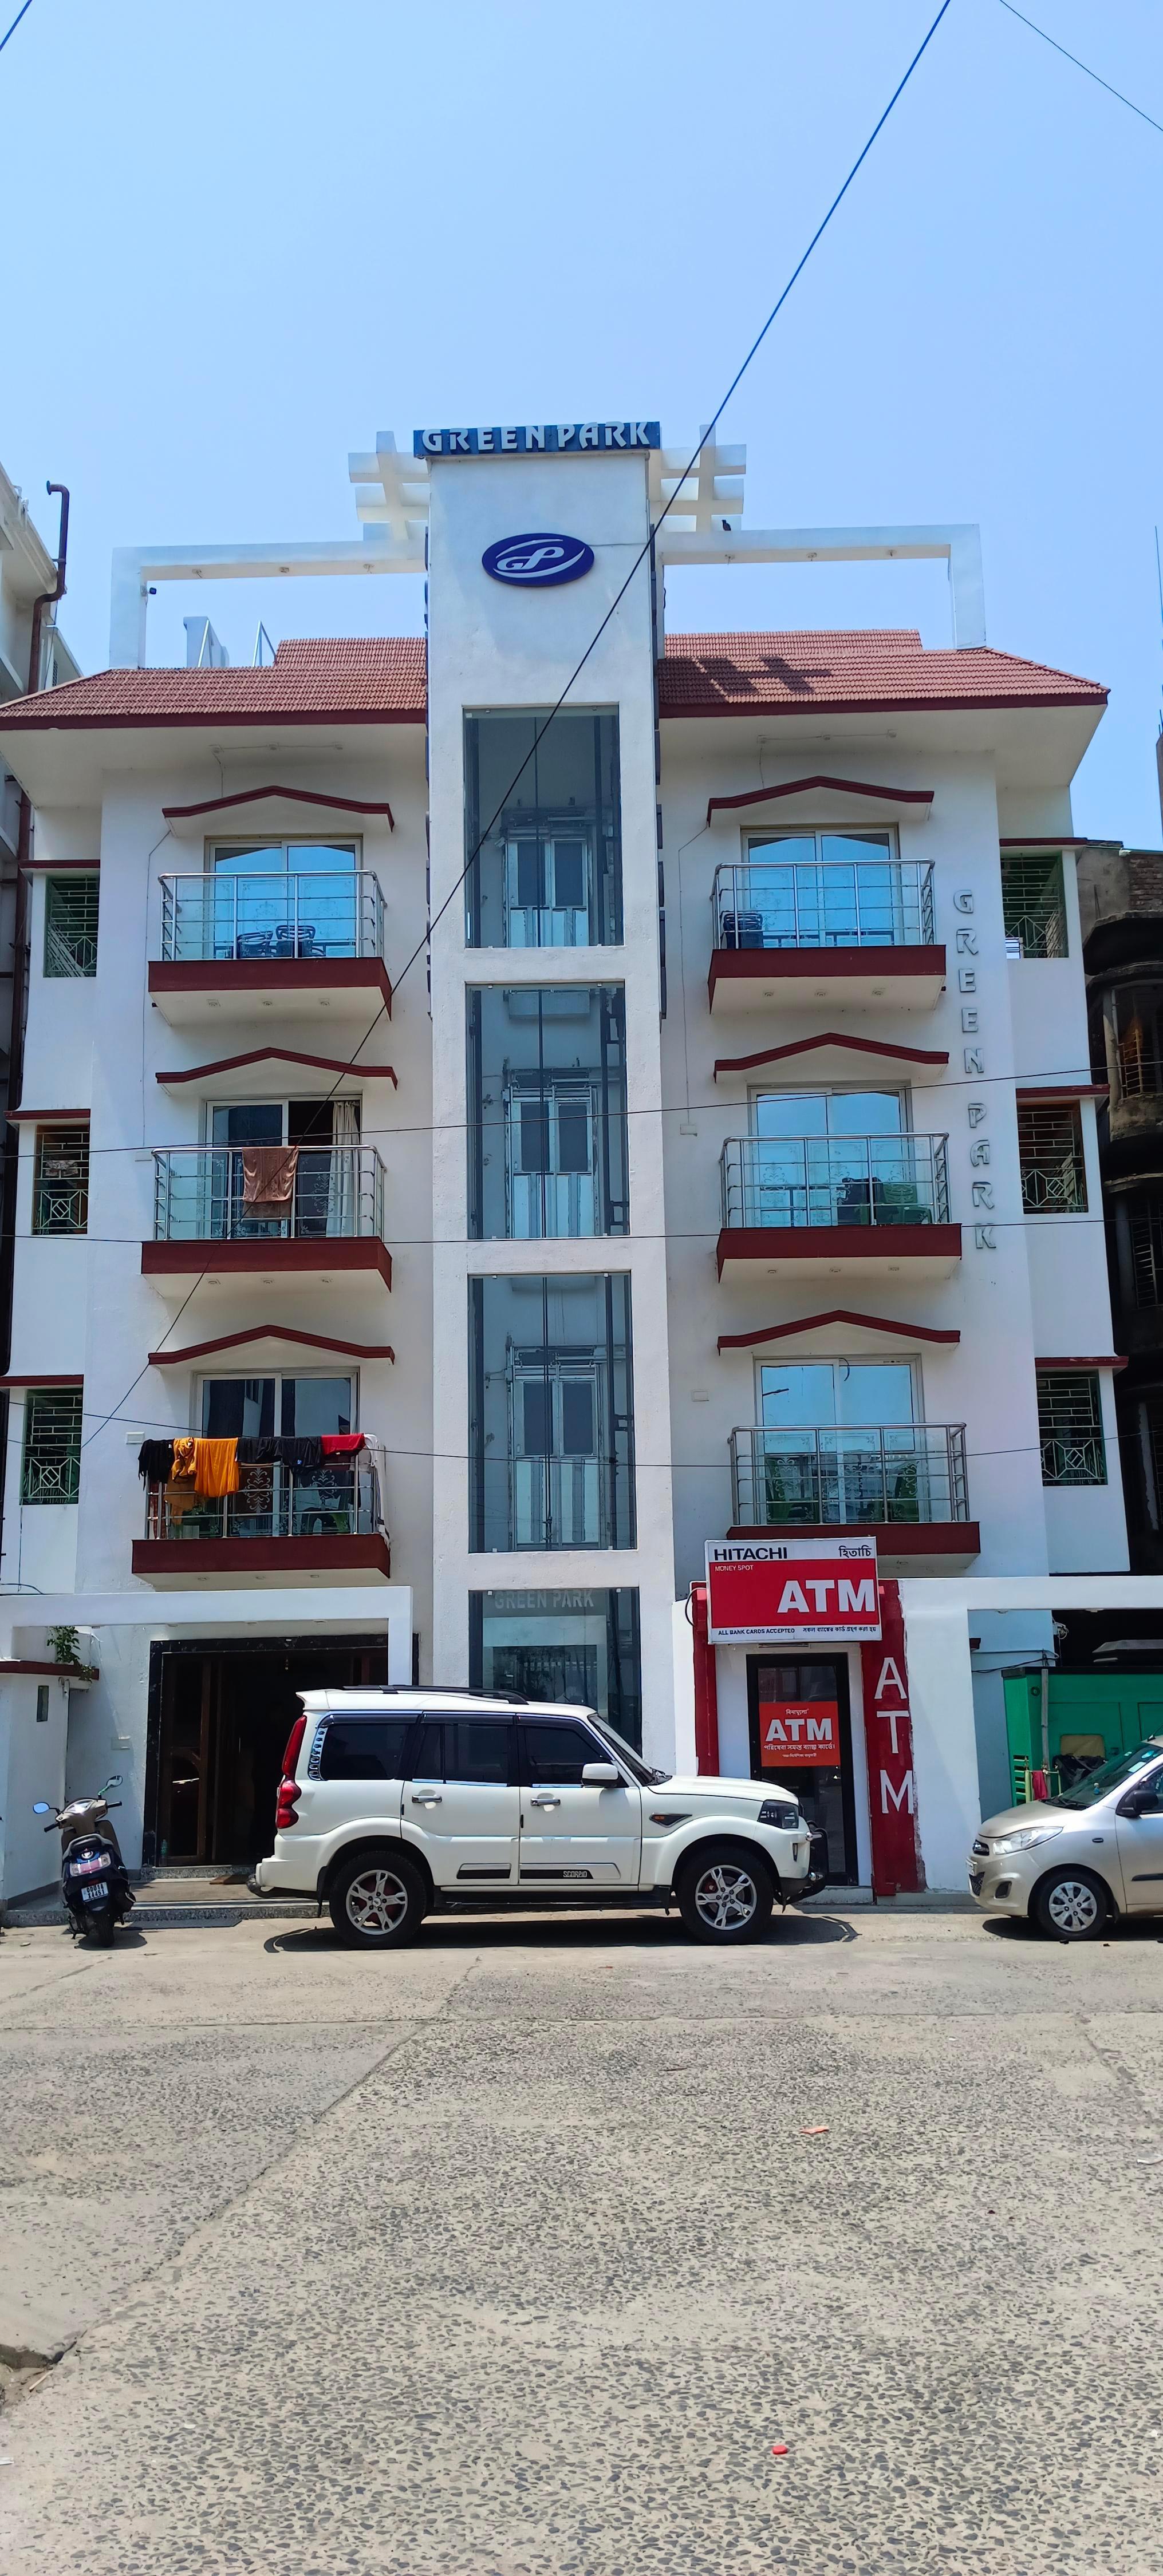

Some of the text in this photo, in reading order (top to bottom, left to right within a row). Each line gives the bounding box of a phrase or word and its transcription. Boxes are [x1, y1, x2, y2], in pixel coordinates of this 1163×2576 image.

[423, 421, 651, 452] GREEN PARK
[496, 546, 565, 571] GP
[953, 889, 997, 1249] GREEN PARK
[713, 1547, 787, 1561] HITACHI
[838, 1544, 872, 1558] হিতাচি
[494, 1589, 594, 1609] GREEN PARK
[776, 1579, 876, 1613] ATM
[765, 1718, 833, 1741] ATM
[874, 1657, 914, 1814] ATM
